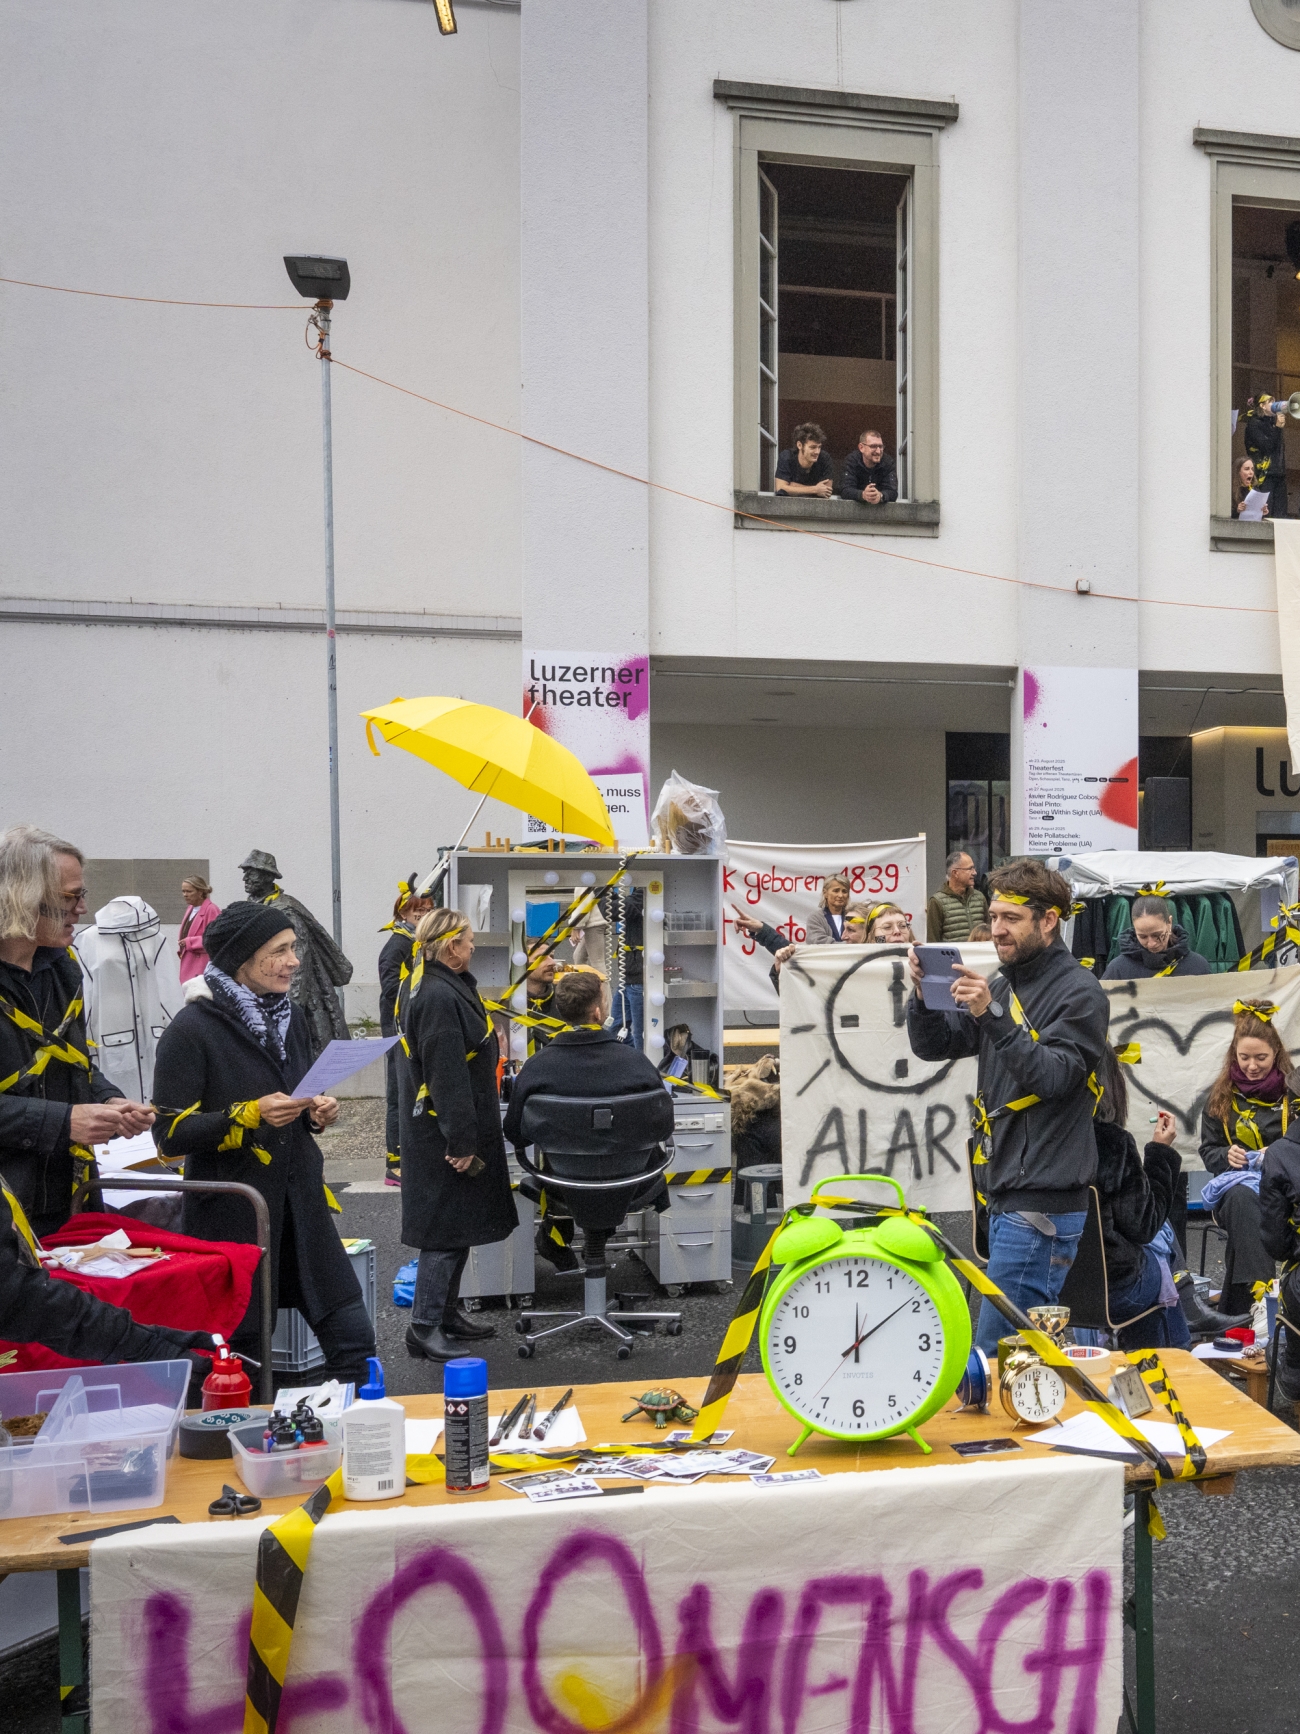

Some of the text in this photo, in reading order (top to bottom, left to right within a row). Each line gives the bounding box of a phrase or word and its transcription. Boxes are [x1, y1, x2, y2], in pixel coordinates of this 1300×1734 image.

[530, 659, 645, 684] luzerner
[528, 683, 632, 708] theater
[606, 788, 641, 797] muss
[799, 1094, 975, 1186] ALAR
[844, 1269, 869, 1288] 12
[886, 1277, 893, 1290] 1
[815, 1282, 831, 1294] 11
[792, 1306, 810, 1319] 10
[912, 1301, 920, 1313] 2
[784, 1336, 797, 1354] 9
[918, 1334, 931, 1352] 3
[794, 1373, 803, 1386] 8
[913, 1370, 922, 1382] 4
[821, 1397, 830, 1409] 7
[888, 1395, 896, 1408] 5
[852, 1399, 865, 1418] 6
